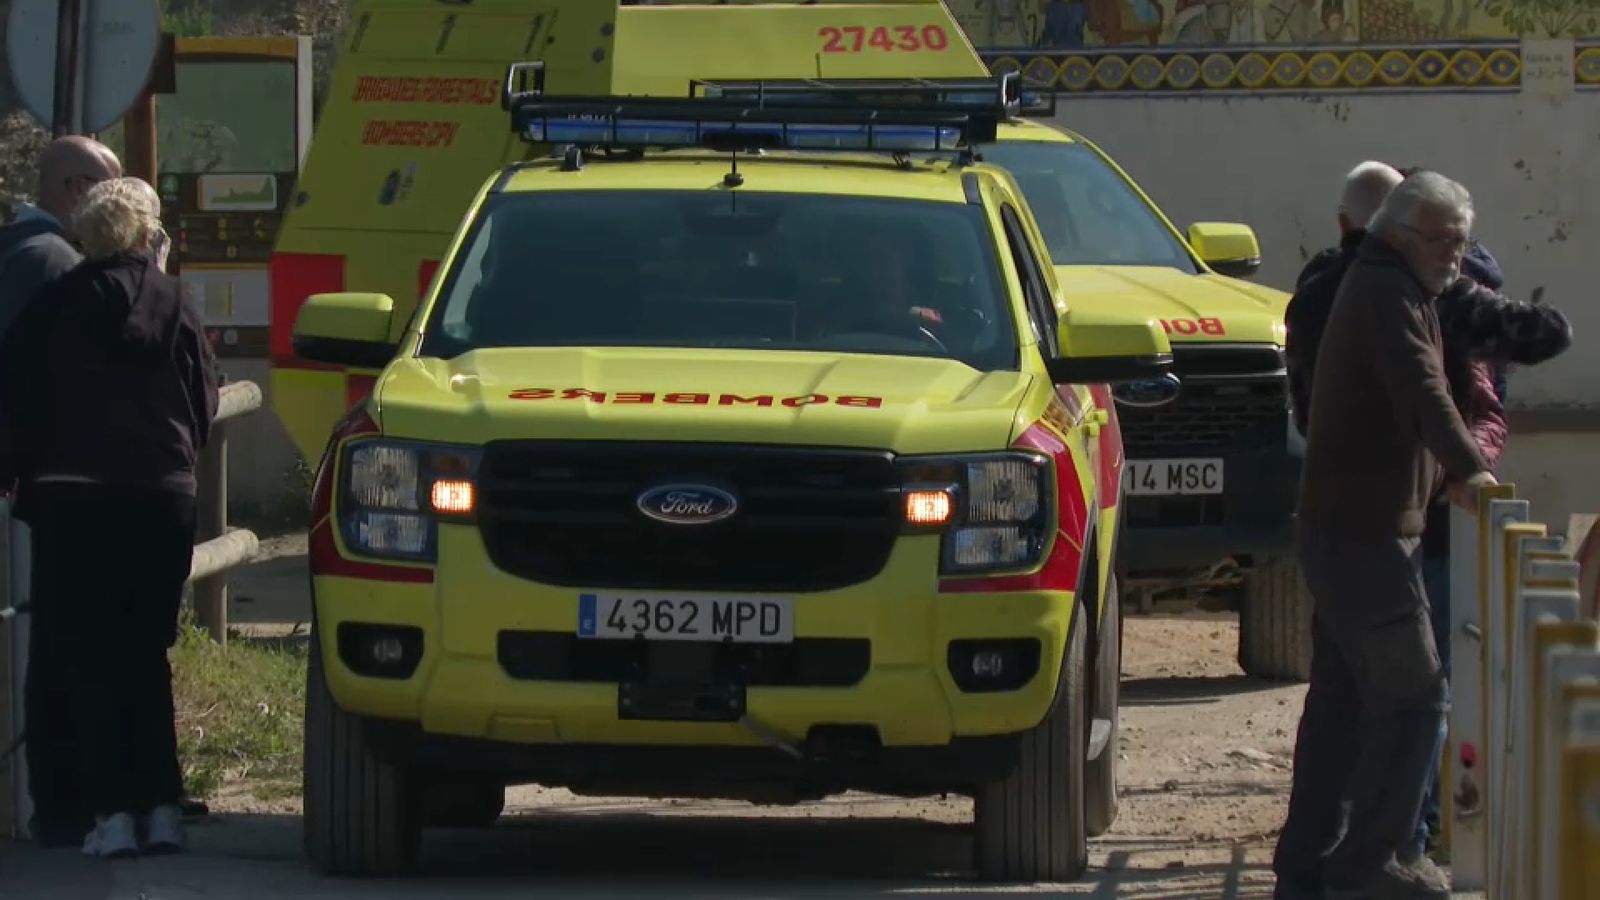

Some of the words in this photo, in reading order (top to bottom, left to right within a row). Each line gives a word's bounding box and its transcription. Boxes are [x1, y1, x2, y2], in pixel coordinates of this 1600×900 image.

[819, 25, 948, 52] 27430
[1128, 465, 1156, 491] 14
[1168, 463, 1216, 490] MSC
[661, 491, 713, 514] Ford
[606, 598, 699, 635] 4362
[711, 600, 781, 637] MPD
